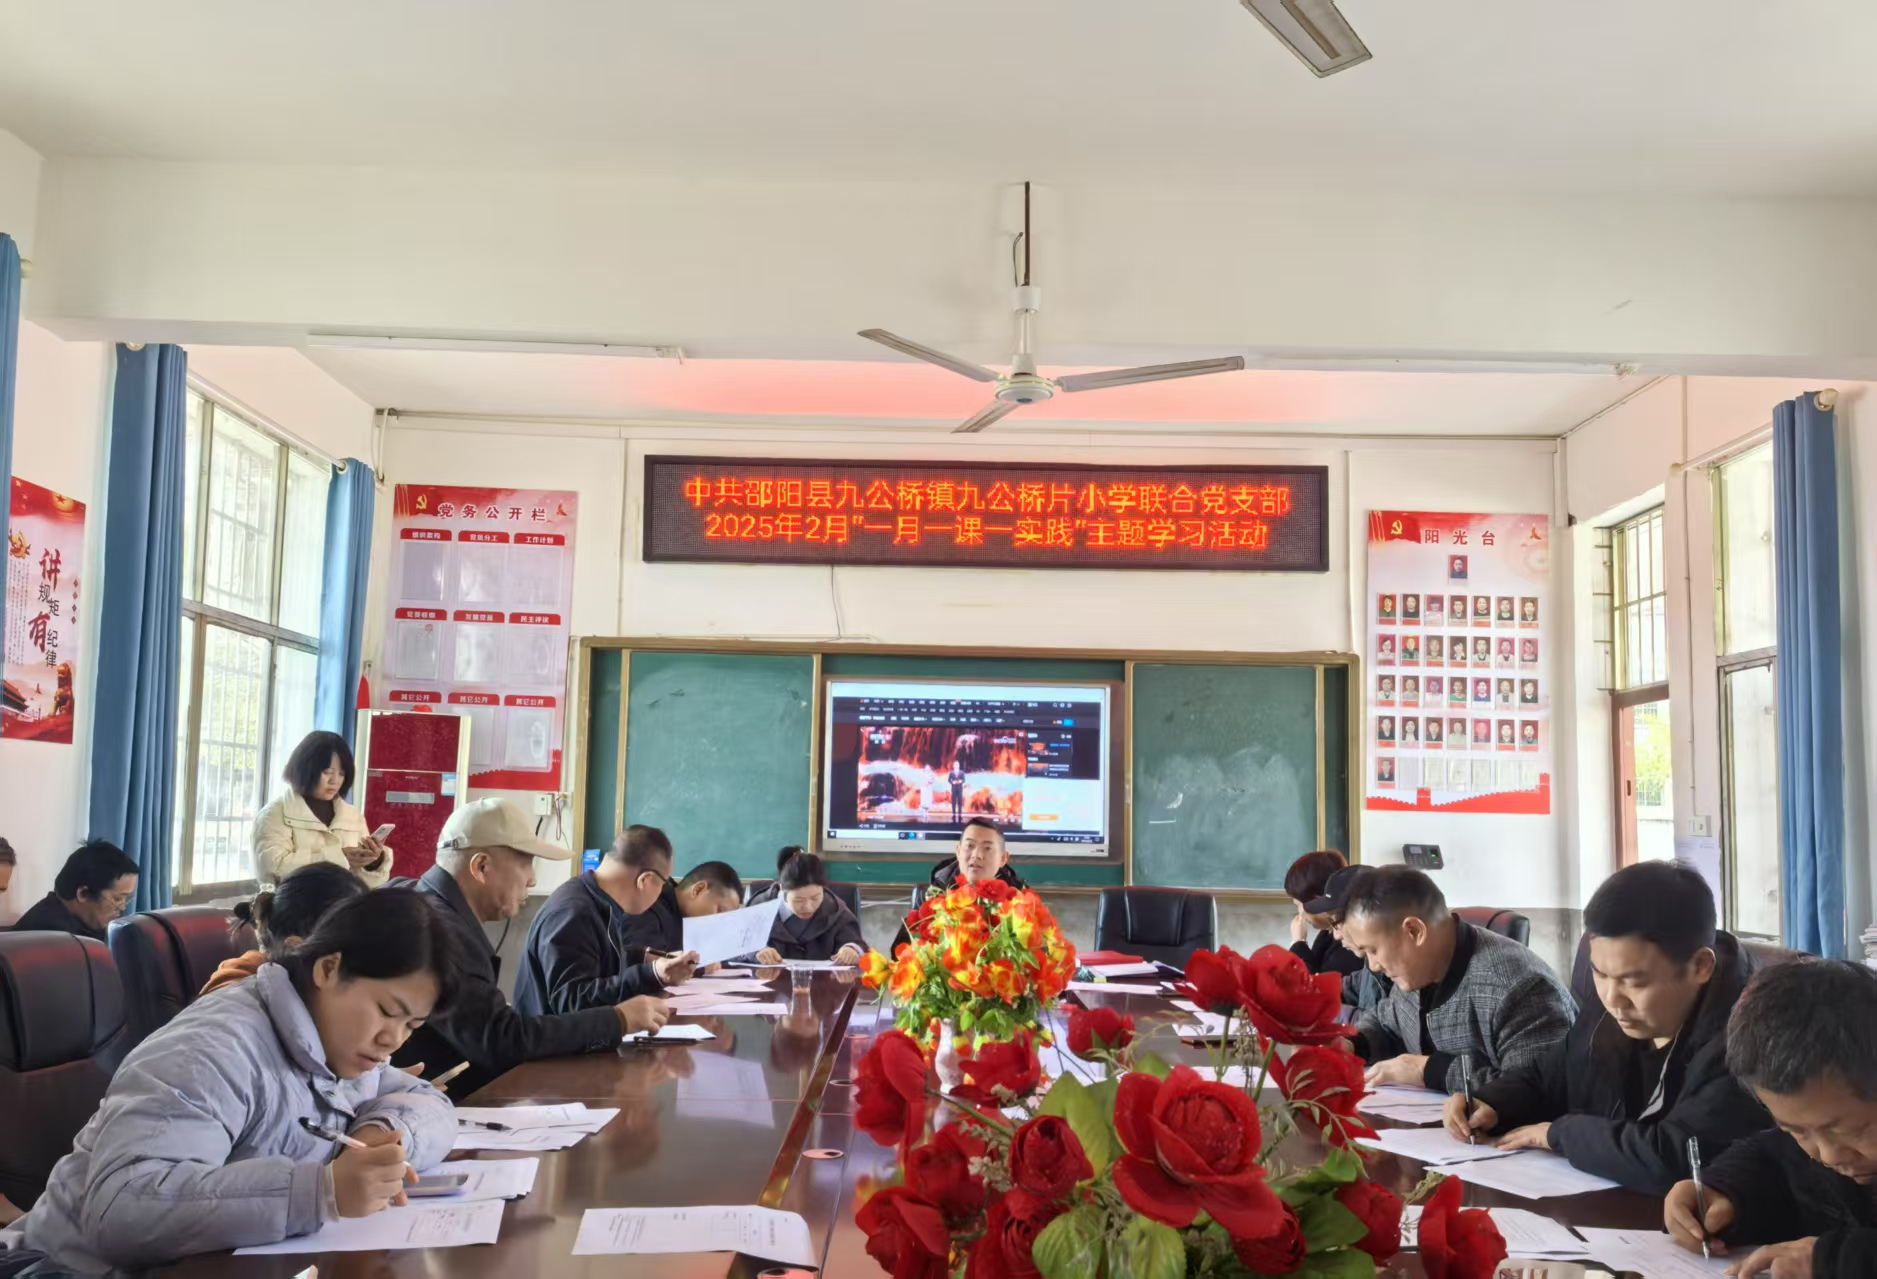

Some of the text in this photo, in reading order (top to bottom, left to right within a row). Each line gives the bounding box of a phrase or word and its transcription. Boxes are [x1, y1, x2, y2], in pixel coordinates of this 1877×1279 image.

[685, 477, 1289, 515] 中共邵阳县九公桥镇九公桥片小学联合党支部
[439, 503, 546, 521] 党务公开栏
[1424, 528, 1496, 546] 阳光台
